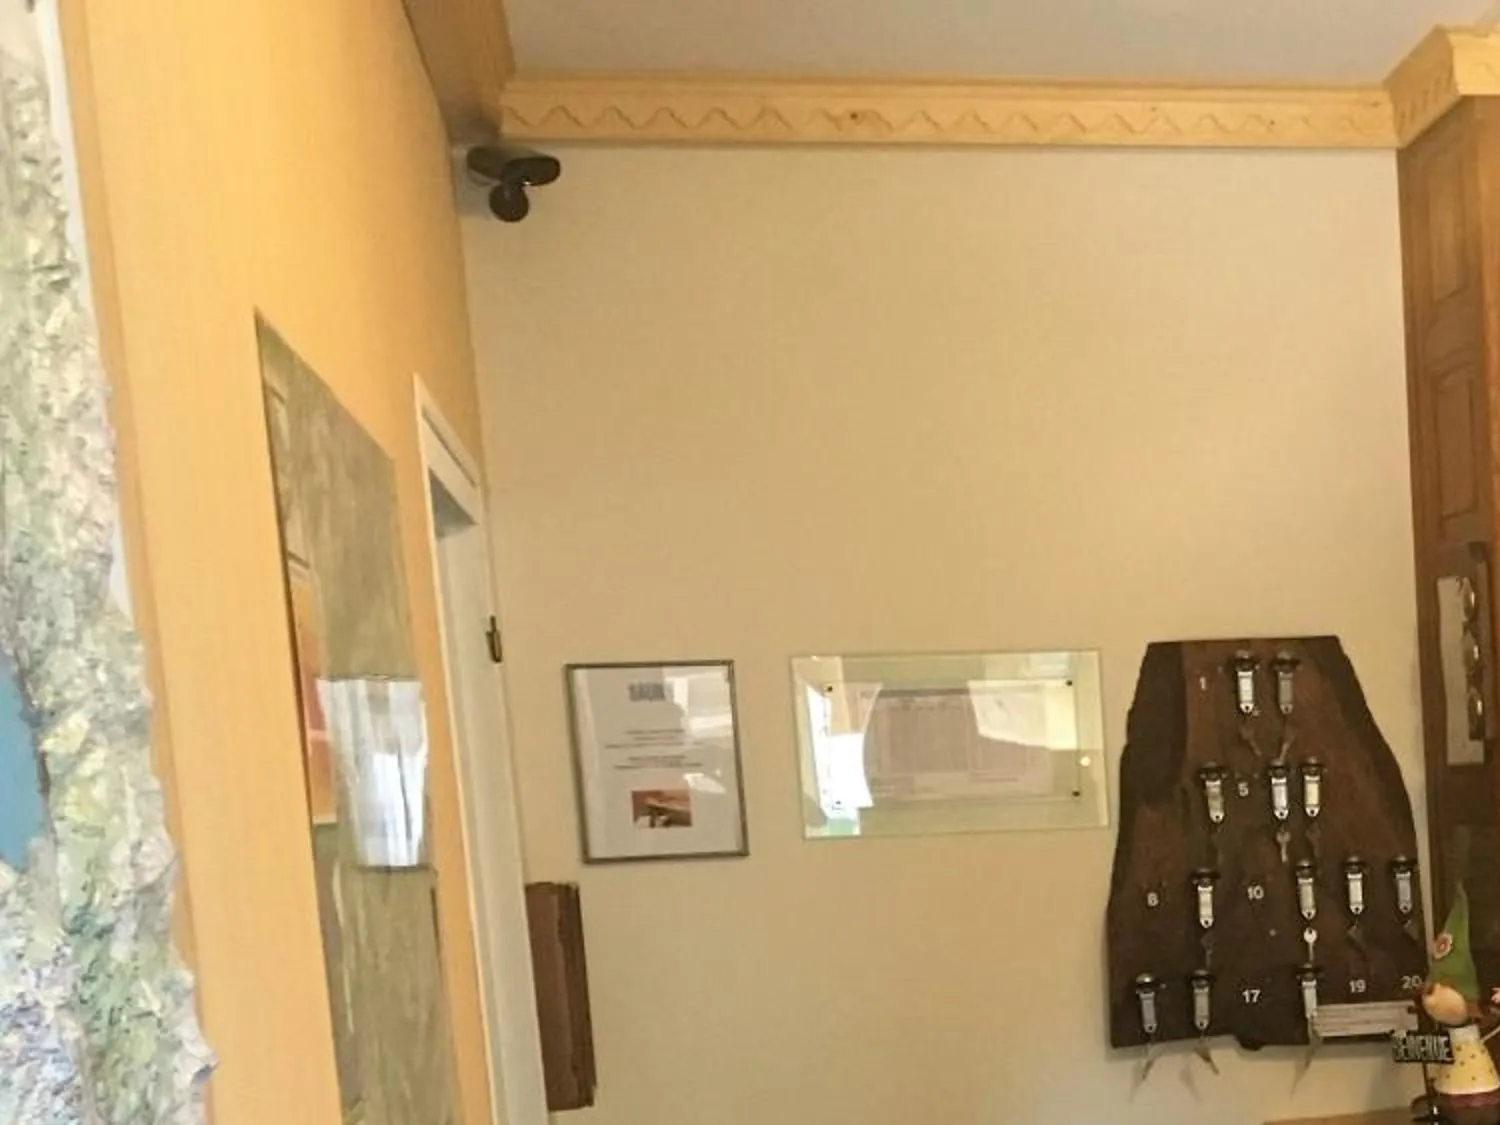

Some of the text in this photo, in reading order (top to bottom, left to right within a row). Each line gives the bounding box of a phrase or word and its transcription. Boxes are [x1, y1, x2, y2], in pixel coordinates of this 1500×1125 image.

[1237, 782, 1249, 797] 5
[1247, 885, 1264, 900] 10
[1349, 979, 1366, 993] 19
[1401, 975, 1422, 989] 20
[1242, 989, 1261, 1004] 17
